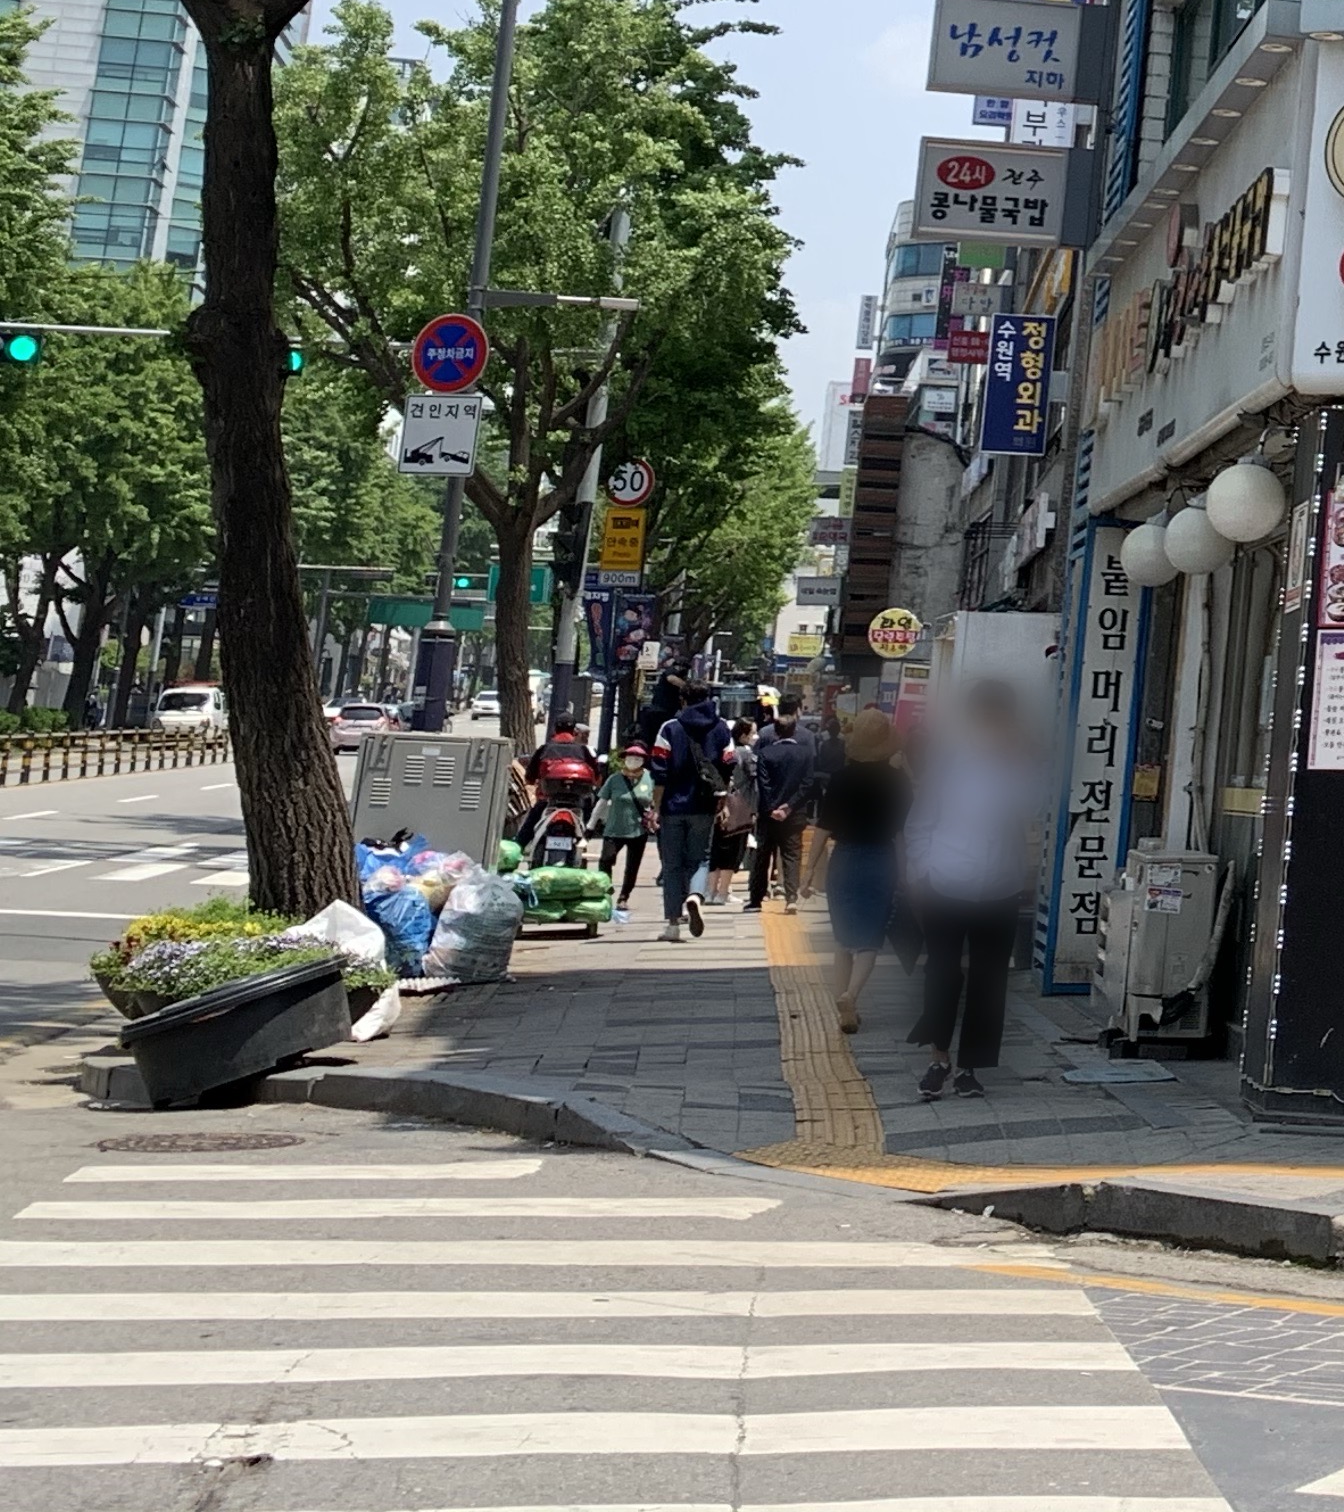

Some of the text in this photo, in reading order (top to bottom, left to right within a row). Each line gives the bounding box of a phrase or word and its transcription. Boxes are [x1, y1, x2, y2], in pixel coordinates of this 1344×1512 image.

[1025, 68, 1065, 90] 지하
[945, 160, 989, 186] 24시
[930, 191, 1050, 228] 콩나물국밥
[1013, 320, 1048, 435] 정형외과
[409, 402, 478, 421] 견인지역
[612, 470, 645, 493] 50
